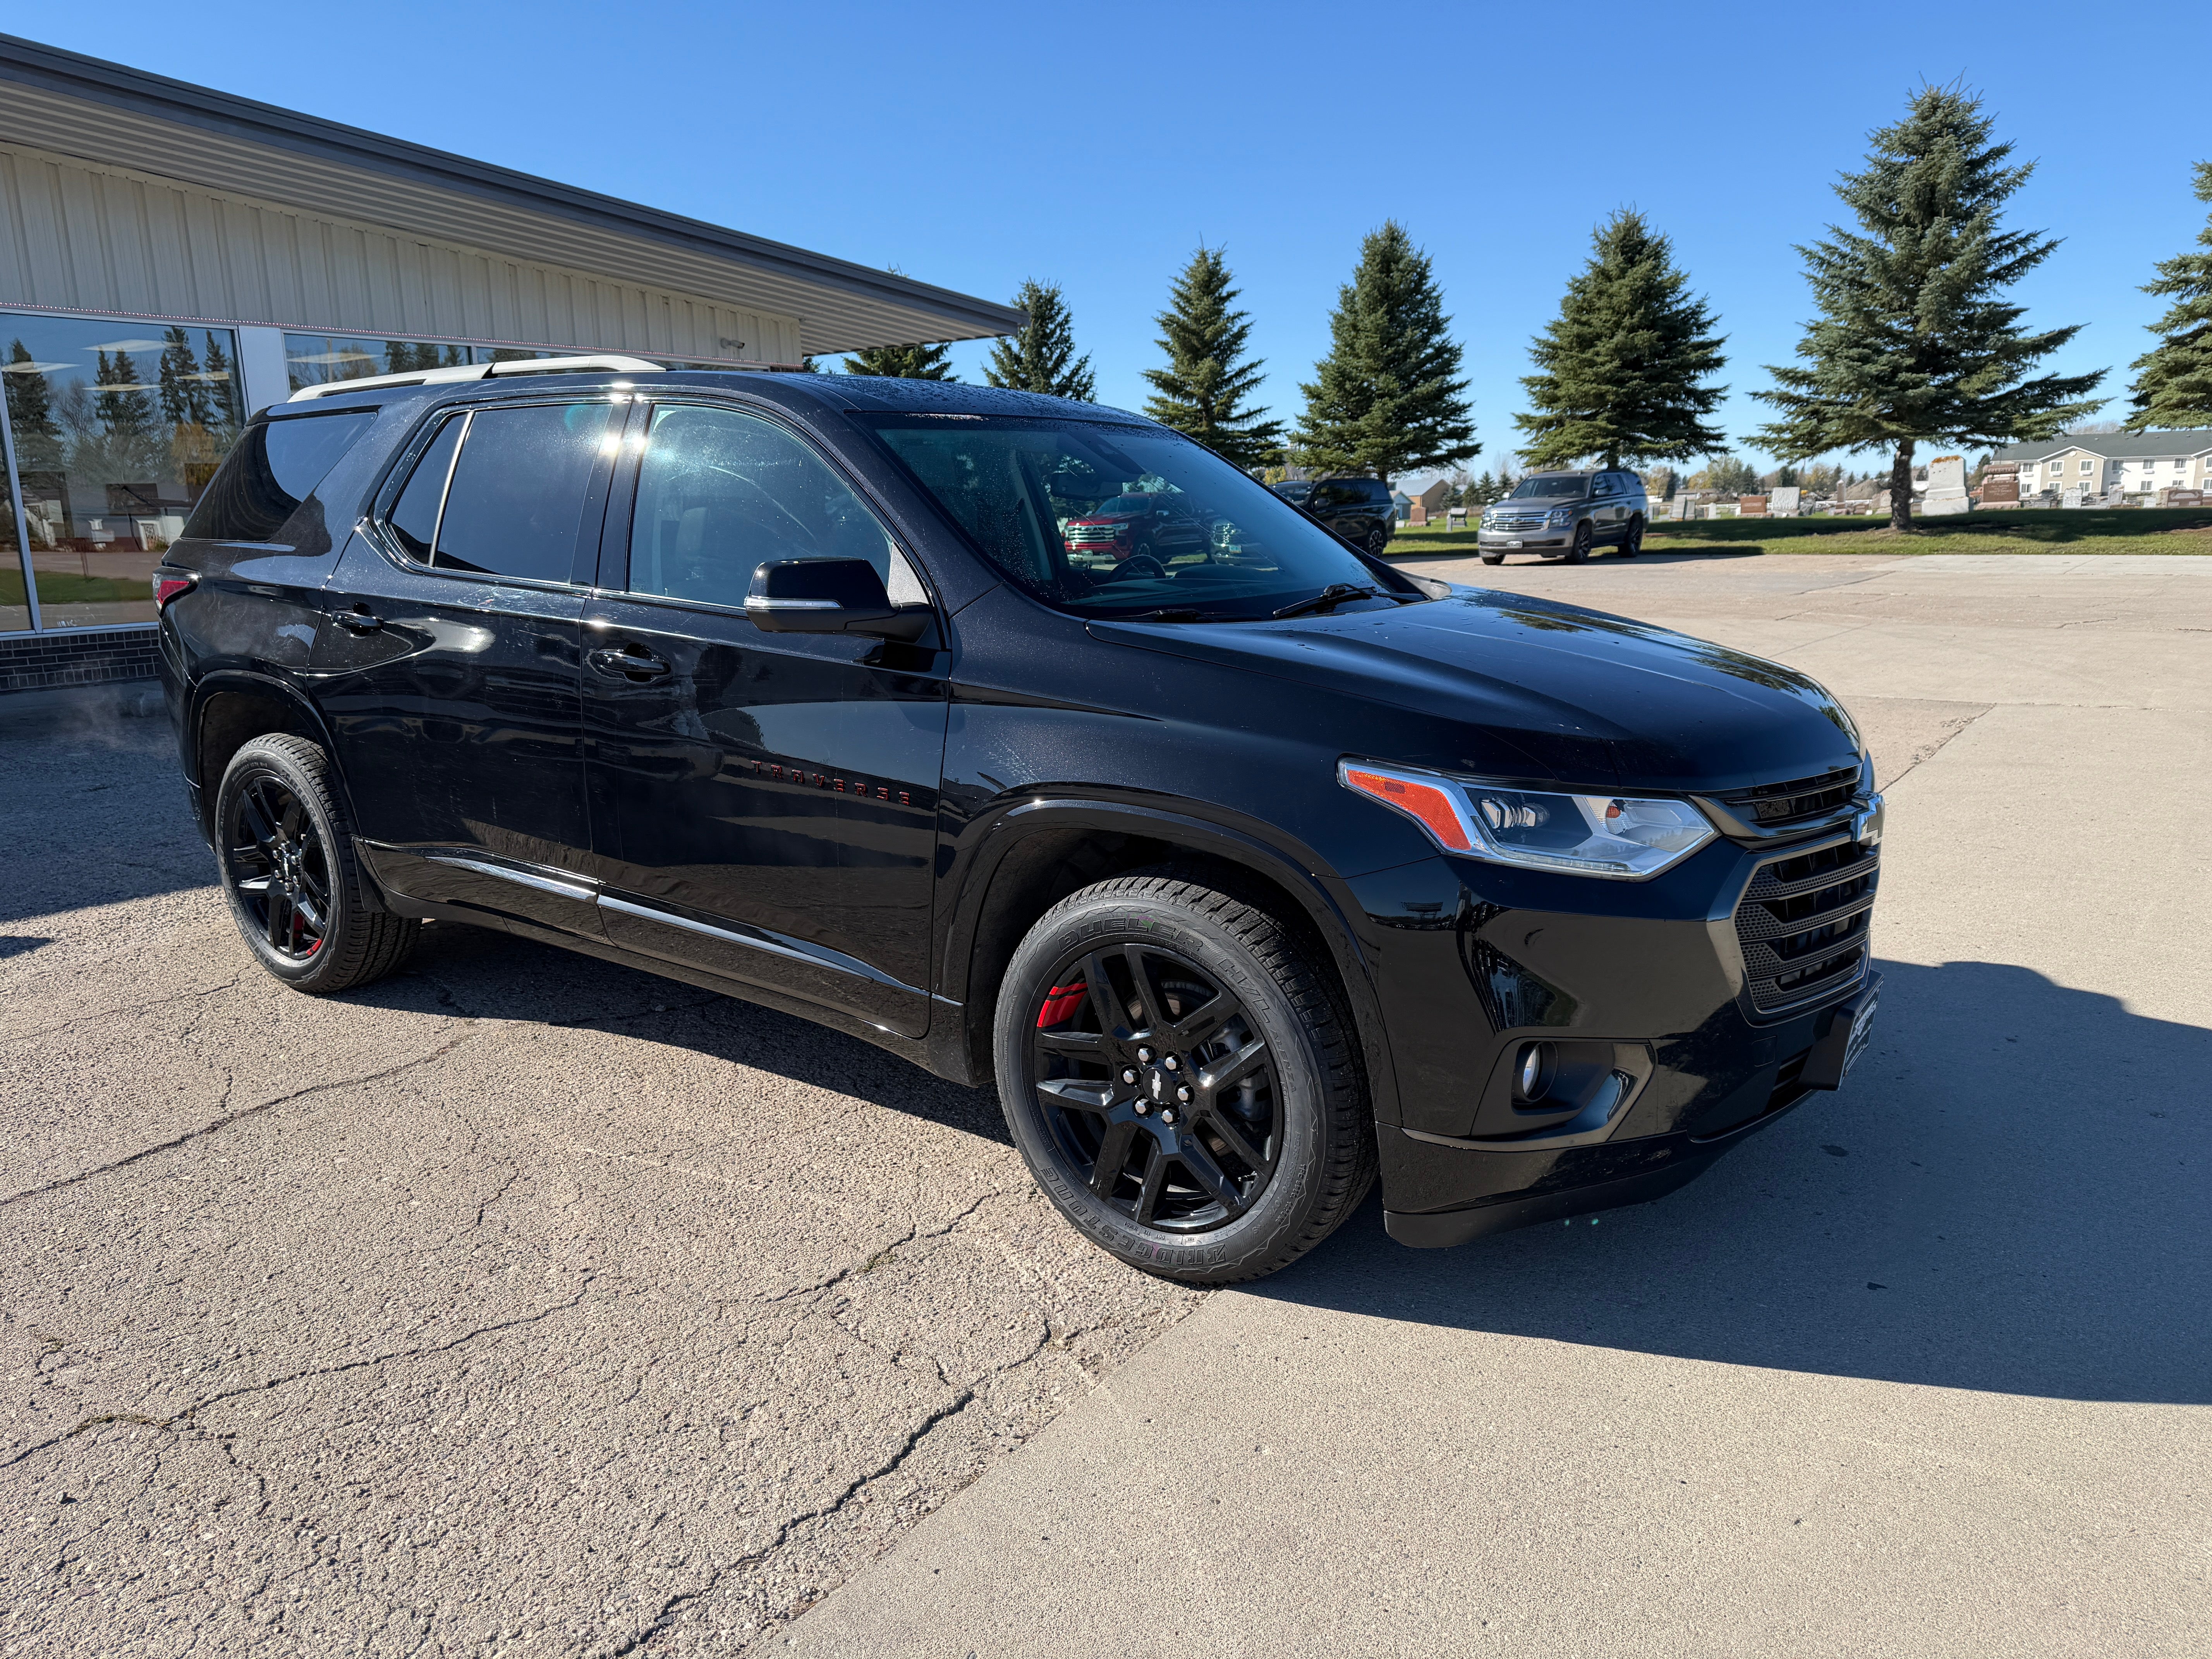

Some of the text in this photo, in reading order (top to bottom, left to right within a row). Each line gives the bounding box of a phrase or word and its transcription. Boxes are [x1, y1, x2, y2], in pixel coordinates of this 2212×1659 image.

[751, 760, 910, 805] TRAVERSE
[1057, 917, 1204, 951] DUELER
[1269, 1029, 1297, 1092] ALENZA
[1040, 1166, 1227, 1265] BRIDGESTONE
